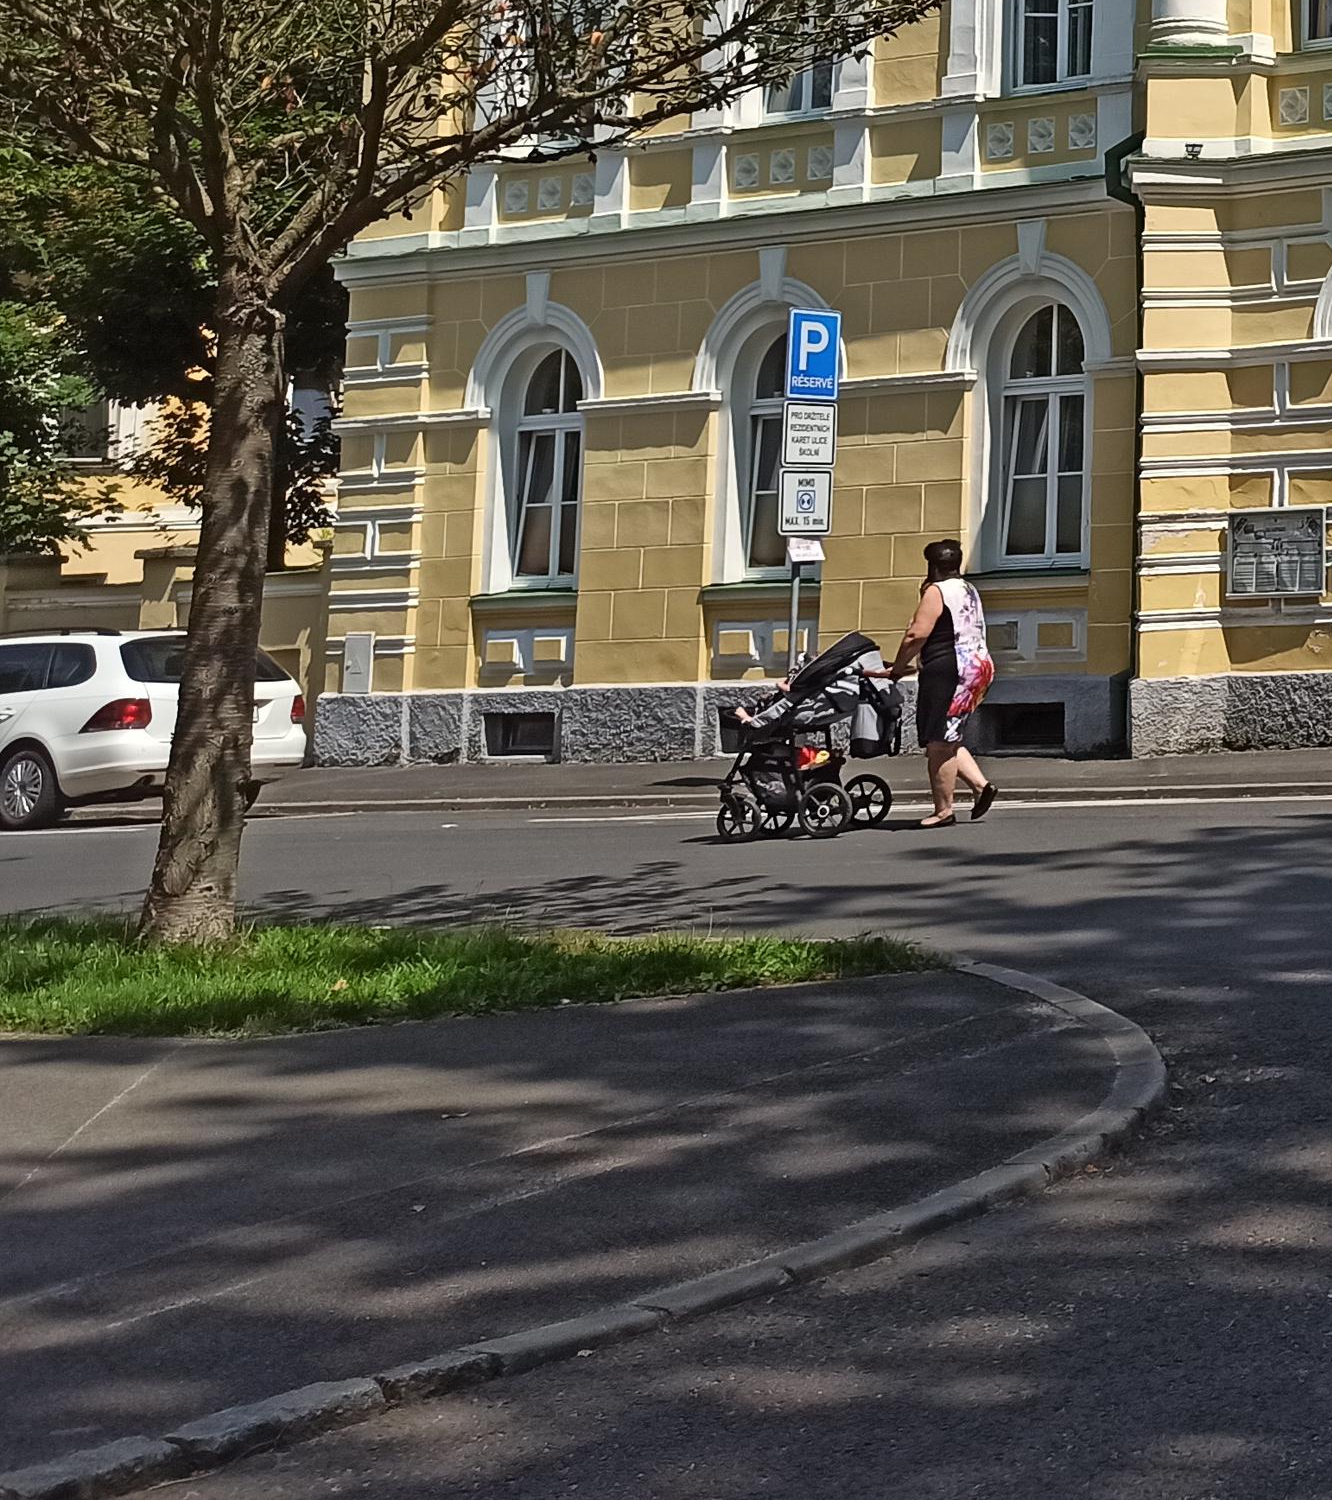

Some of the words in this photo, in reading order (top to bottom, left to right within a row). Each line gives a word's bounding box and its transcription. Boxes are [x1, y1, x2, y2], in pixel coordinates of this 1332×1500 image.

[799, 321, 830, 371] P
[791, 373, 834, 390] RÉSERVÉ
[790, 411, 803, 420] PRO
